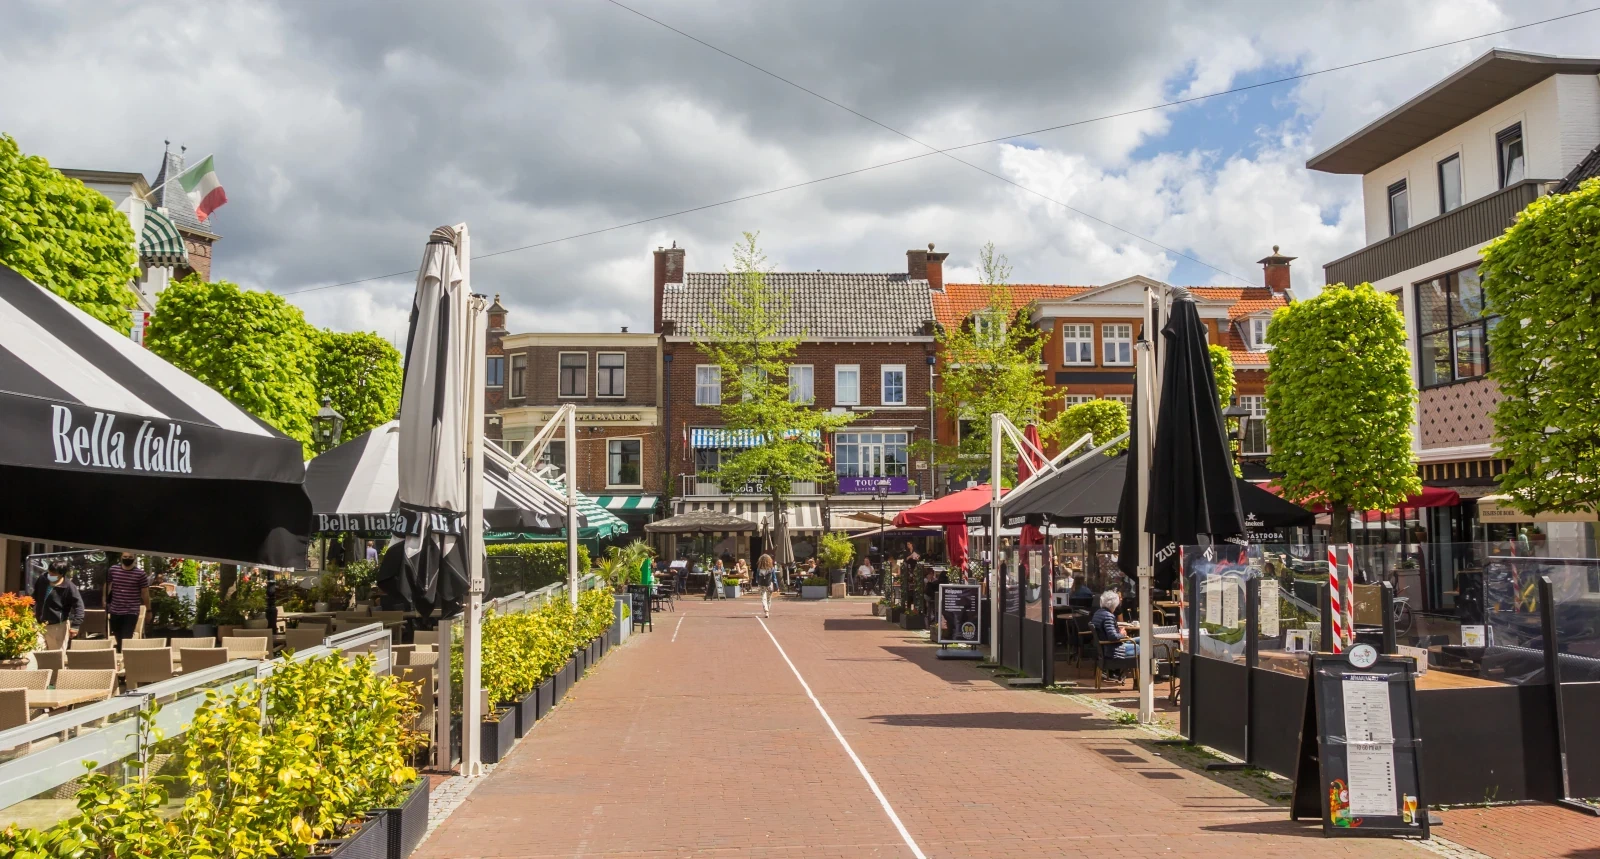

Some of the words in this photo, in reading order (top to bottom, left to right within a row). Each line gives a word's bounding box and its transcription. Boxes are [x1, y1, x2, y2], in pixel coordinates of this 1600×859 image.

[51, 404, 126, 469] Bella
[133, 420, 192, 473] Italia
[855, 478, 892, 486] TOUCÉ
[319, 514, 360, 531] Bella
[364, 514, 398, 531] Ital
[1083, 516, 1117, 524] ZUSJES
